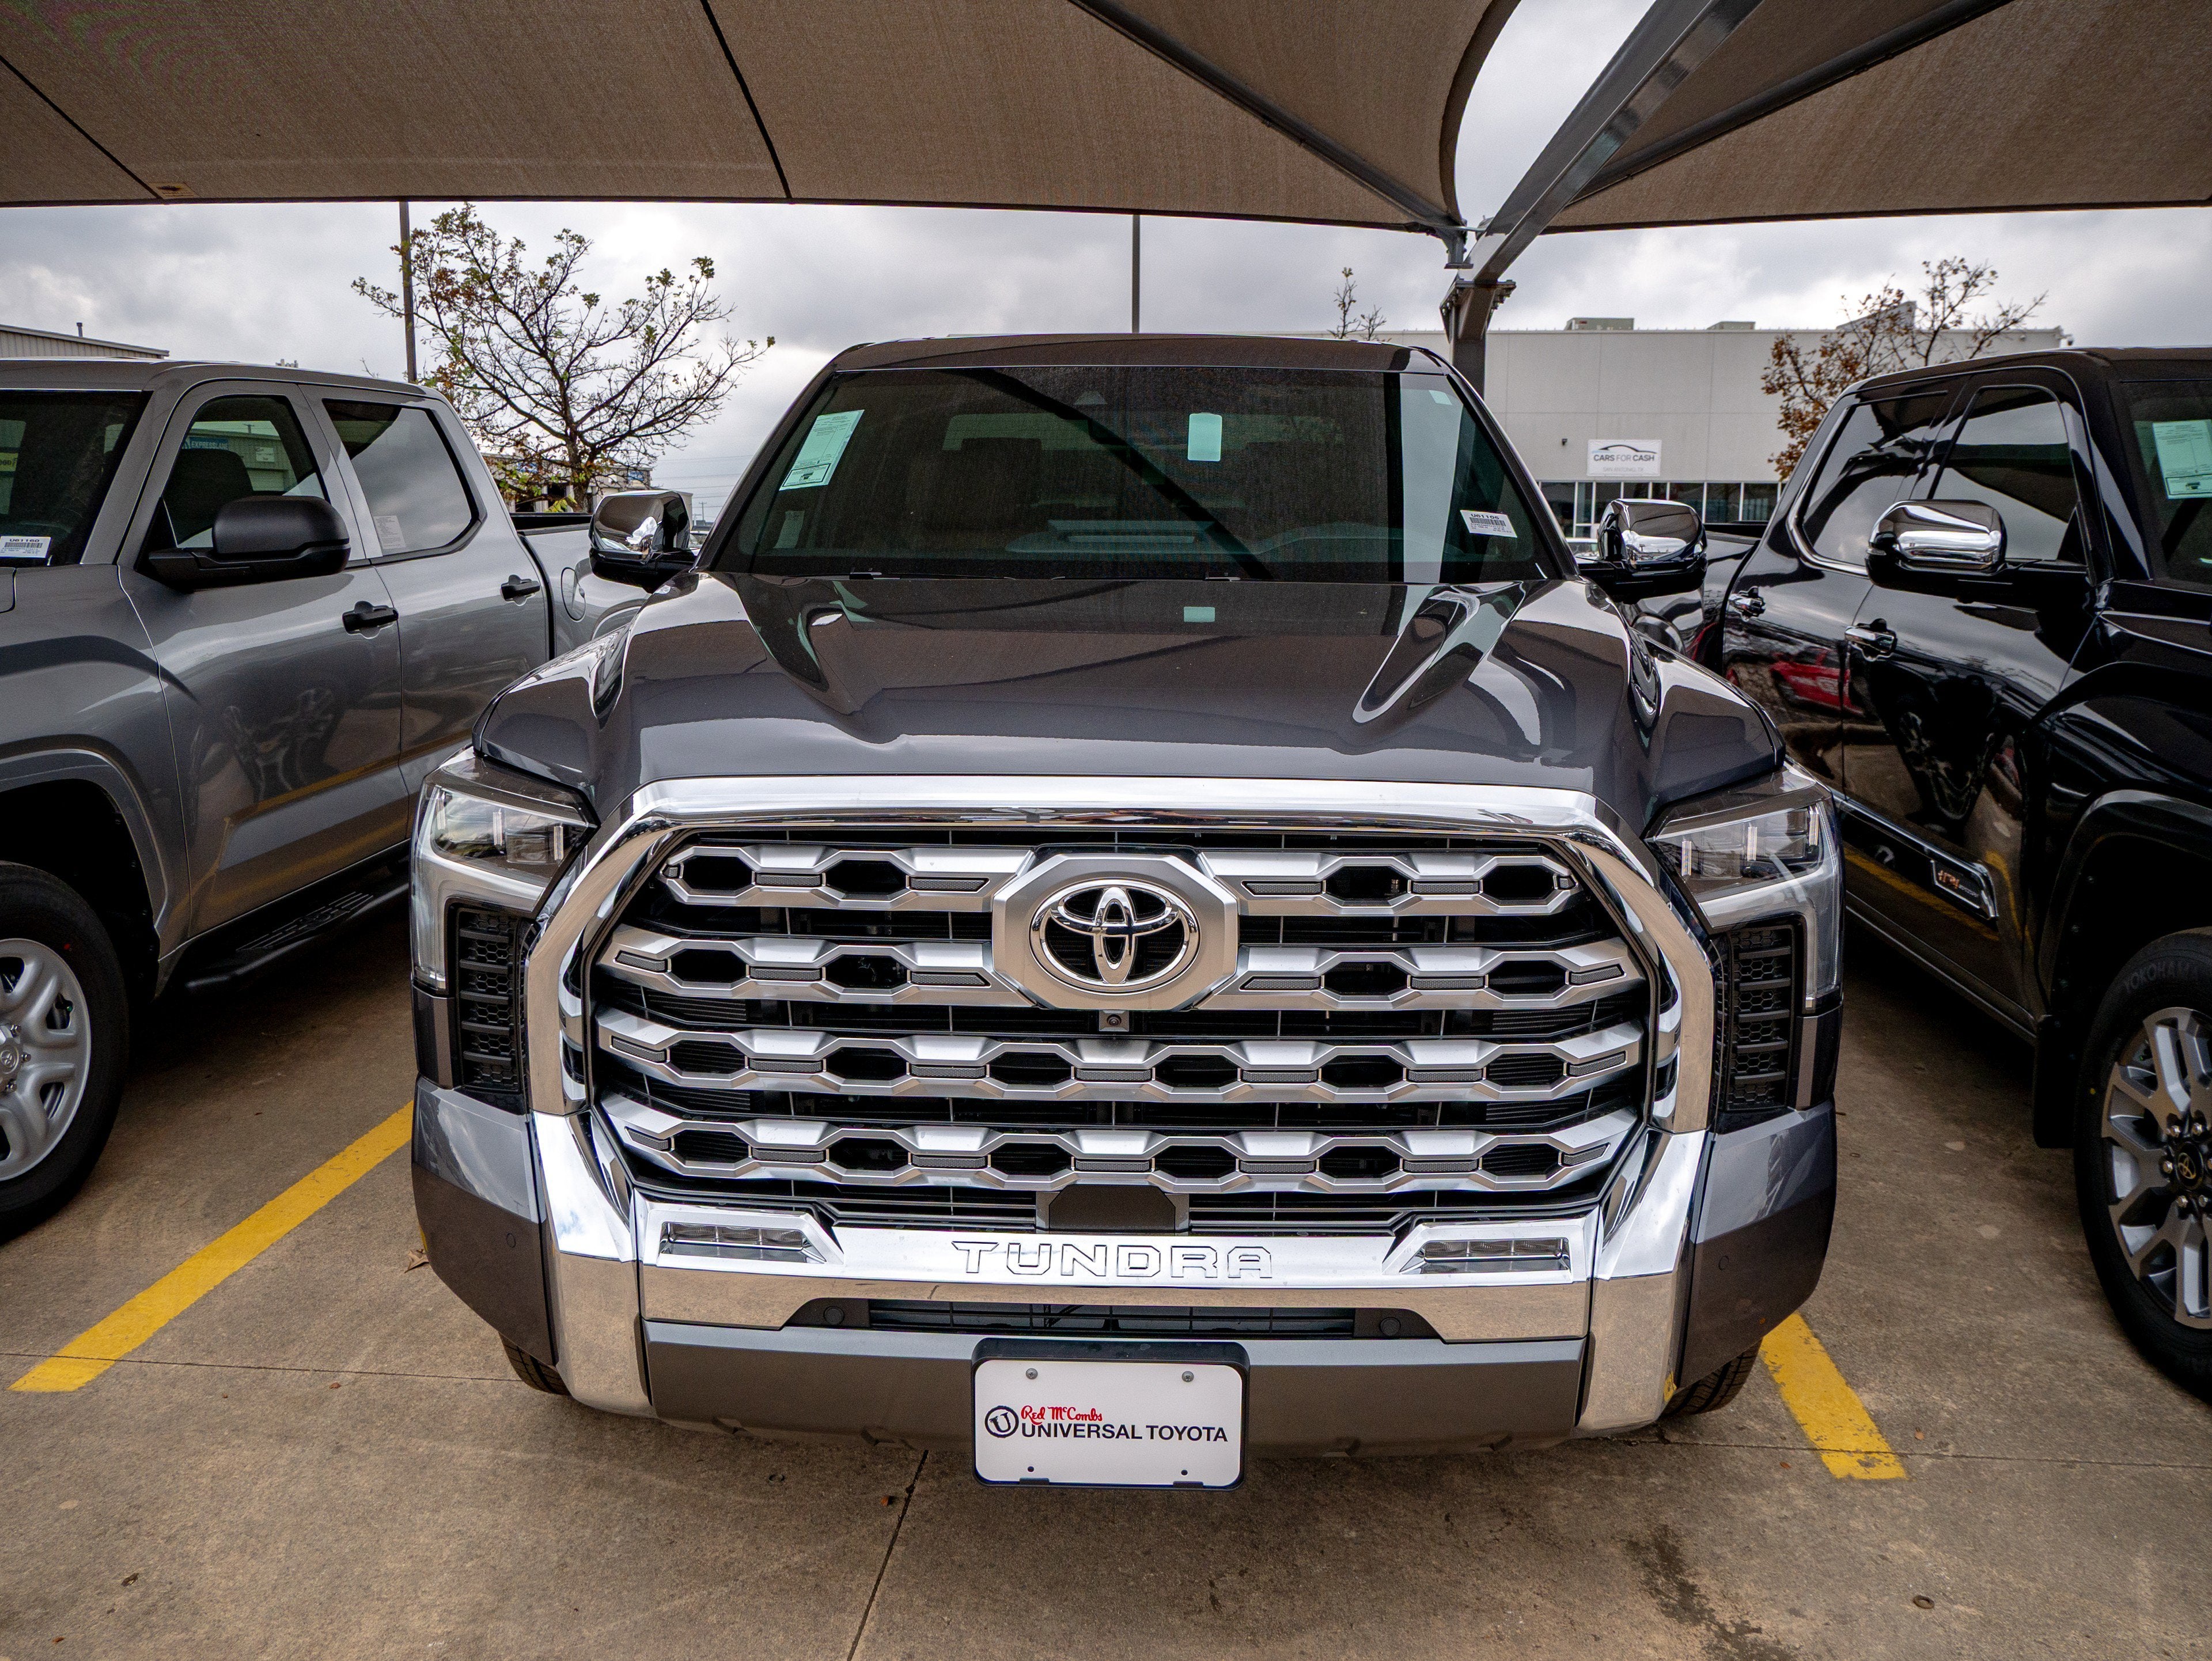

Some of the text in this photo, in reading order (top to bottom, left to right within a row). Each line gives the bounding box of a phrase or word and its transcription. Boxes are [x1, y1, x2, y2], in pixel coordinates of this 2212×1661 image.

[951, 1240, 1273, 1278] TUNDRA
[1021, 1405, 1103, 1426] Red McCombs
[1021, 1422, 1228, 1443] UNIVERSAL TOYOTA
